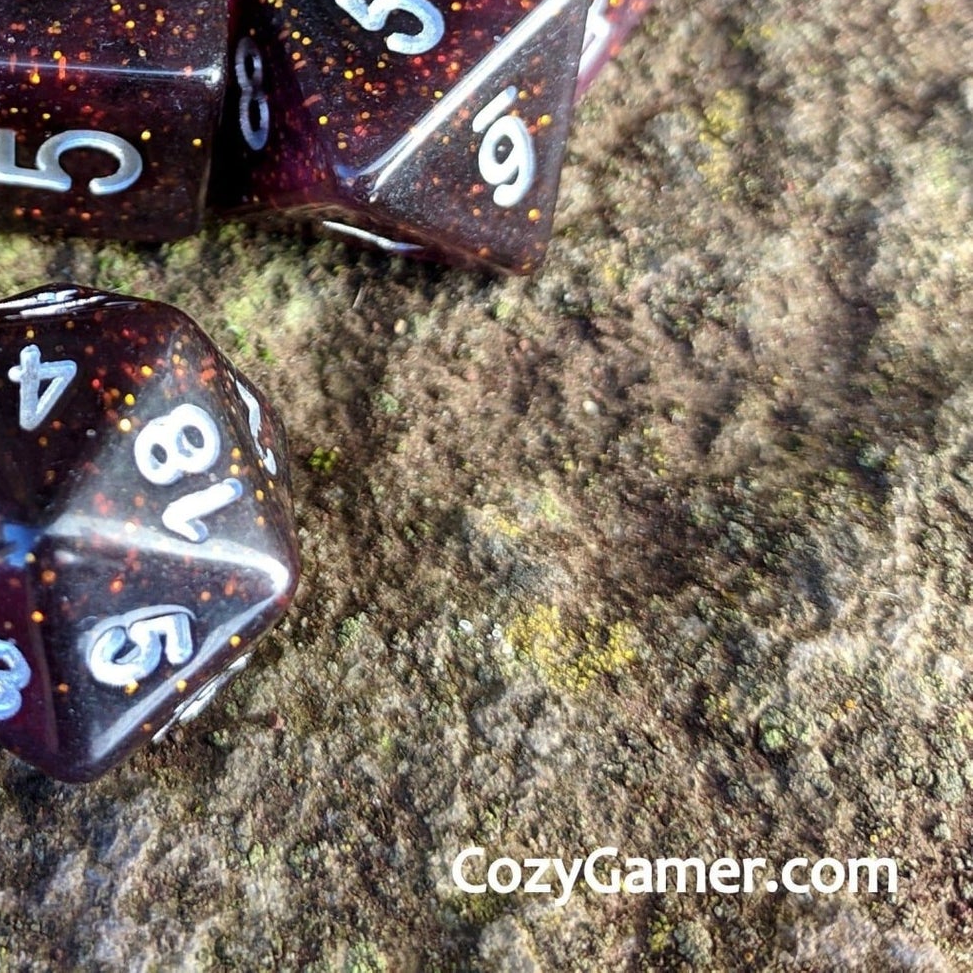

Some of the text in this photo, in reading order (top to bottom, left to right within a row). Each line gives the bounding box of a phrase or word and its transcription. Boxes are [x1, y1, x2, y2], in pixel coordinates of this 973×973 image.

[234, 37, 270, 151] 8
[8, 344, 78, 431] 4
[133, 403, 244, 543] 18
[86, 604, 195, 686] 5
